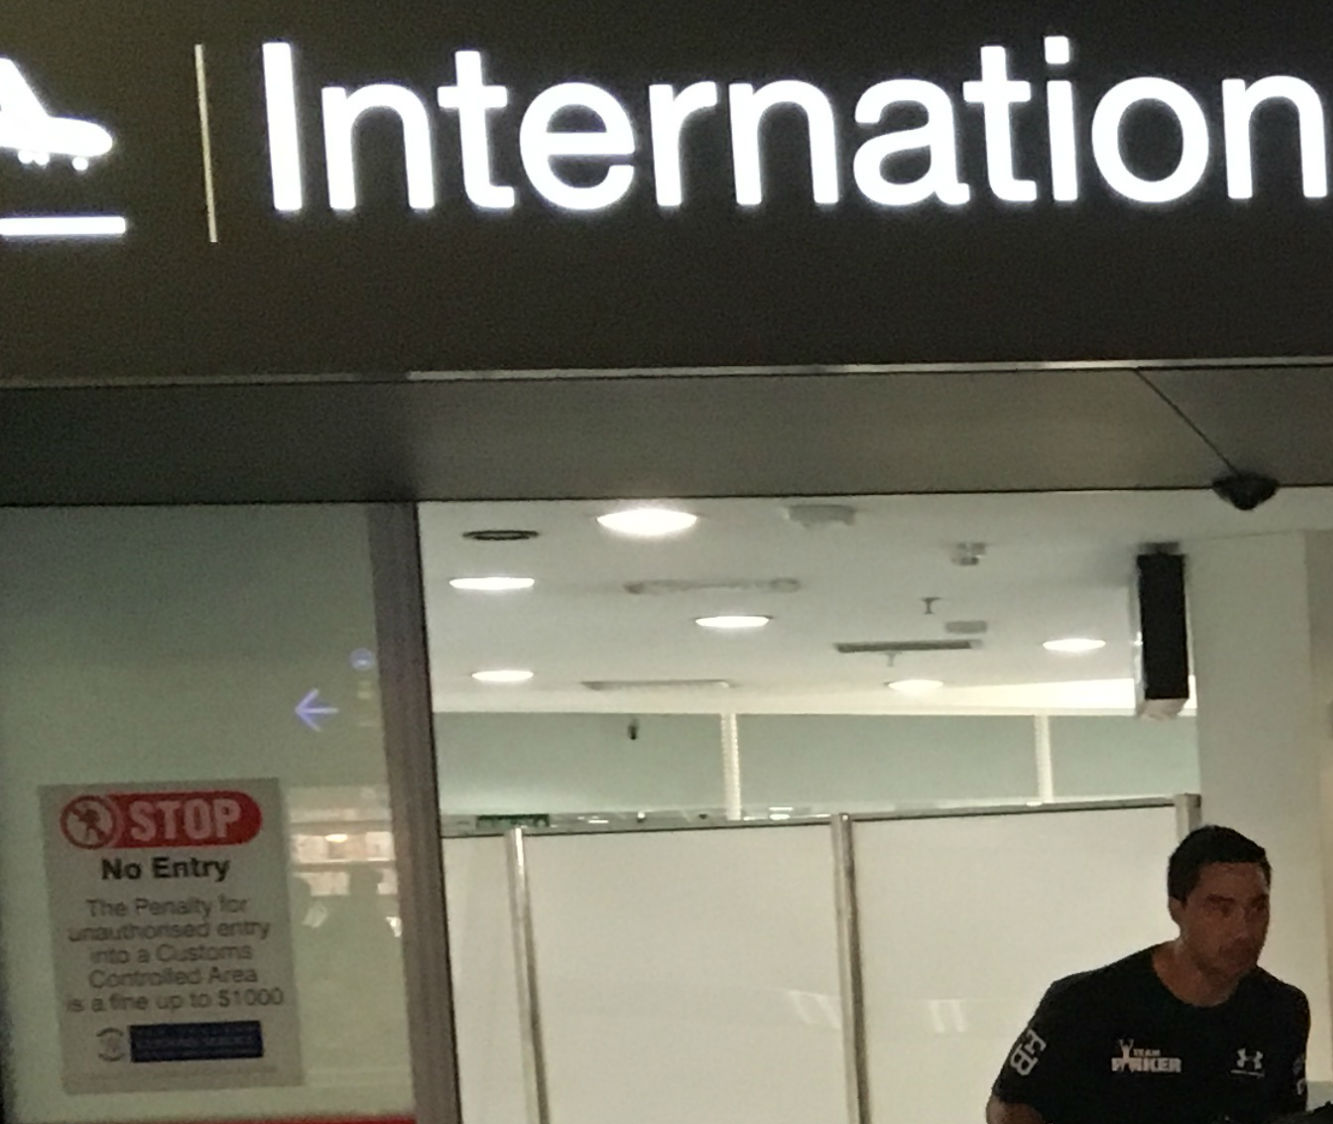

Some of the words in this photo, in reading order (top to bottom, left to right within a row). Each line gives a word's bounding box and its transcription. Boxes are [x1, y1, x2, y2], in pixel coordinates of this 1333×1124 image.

[129, 798, 242, 842] STOP
[101, 858, 142, 880] No
[152, 856, 230, 882] Entry
[86, 898, 127, 918] The
[135, 897, 213, 918] Penalty
[217, 893, 248, 913] for
[67, 922, 210, 943] unauthorised
[217, 920, 271, 940] entry
[90, 948, 132, 965] into
[137, 950, 150, 964] a
[155, 943, 254, 963] Customs
[88, 966, 203, 989] Controlled
[208, 965, 259, 984] Area
[91, 998, 105, 1013] a
[108, 992, 149, 1011] fine
[155, 994, 184, 1013] up
[190, 992, 213, 1009] to
[217, 987, 285, 1008] $1000
